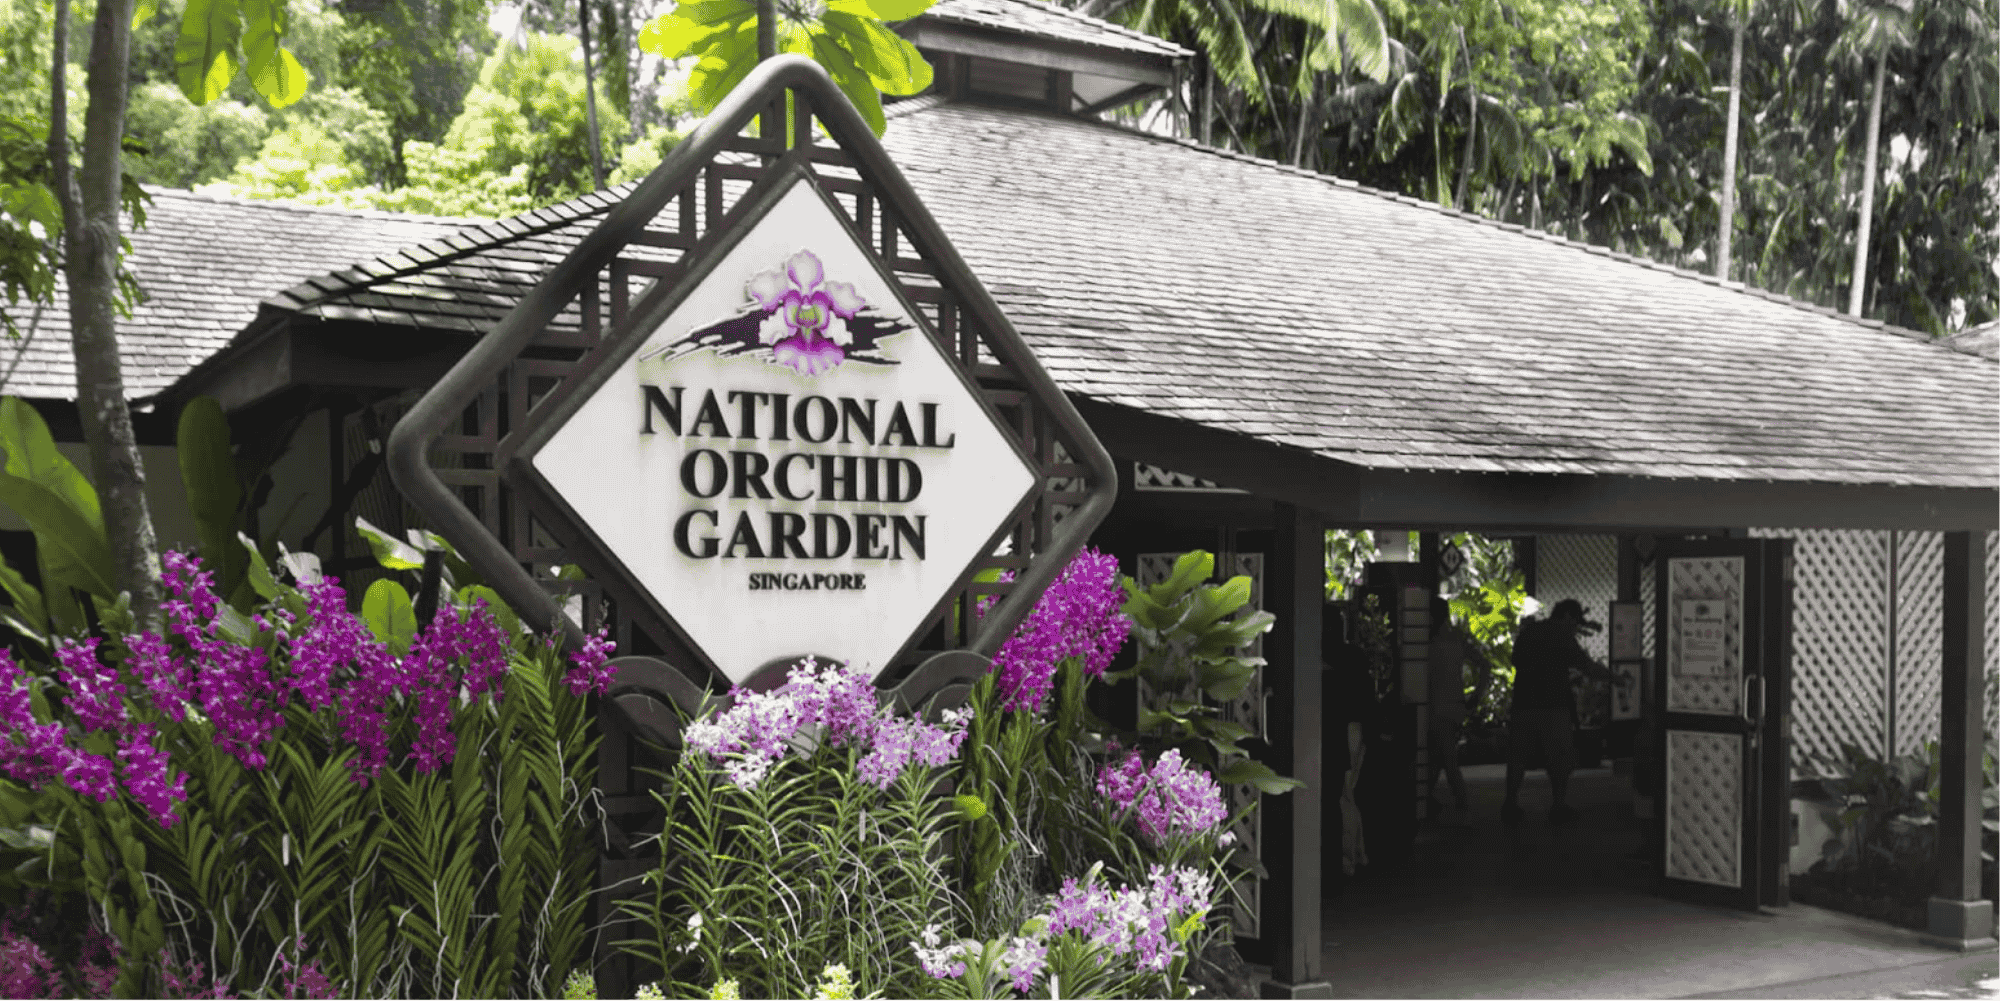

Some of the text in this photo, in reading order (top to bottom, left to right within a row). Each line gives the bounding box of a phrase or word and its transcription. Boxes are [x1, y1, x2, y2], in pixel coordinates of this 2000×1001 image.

[639, 384, 955, 449] NATIONAL
[679, 448, 923, 503] ORCHID
[673, 509, 927, 561] GARDEN
[748, 573, 866, 591] SINGAPORE
